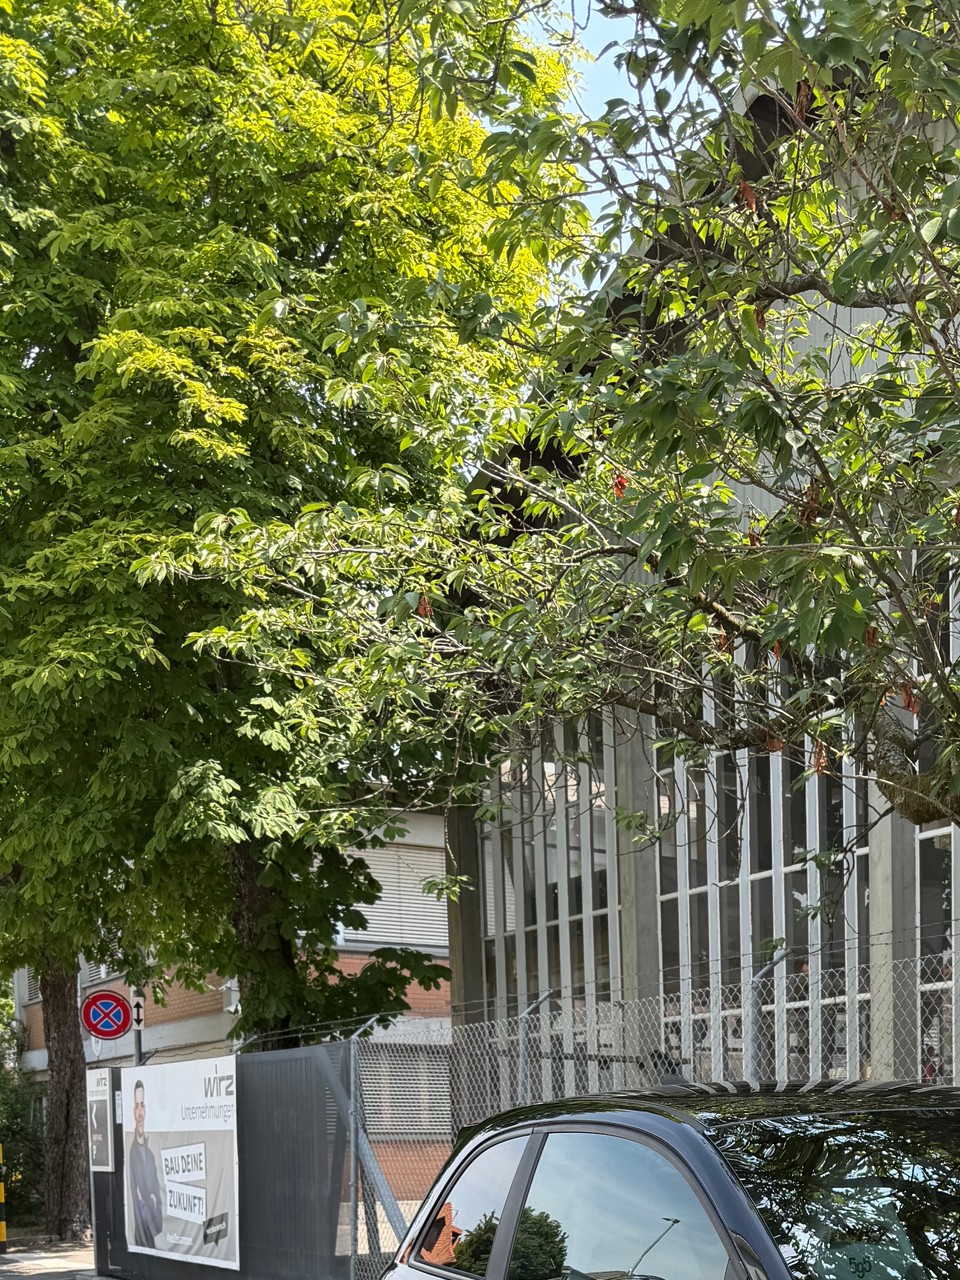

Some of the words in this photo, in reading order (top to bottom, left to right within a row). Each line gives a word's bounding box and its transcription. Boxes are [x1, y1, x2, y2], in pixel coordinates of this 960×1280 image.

[204, 1064, 234, 1098] wirz
[164, 1156, 180, 1175] BAU
[180, 1152, 204, 1173] DEINE
[169, 1190, 204, 1216] ZUKUNFT!
